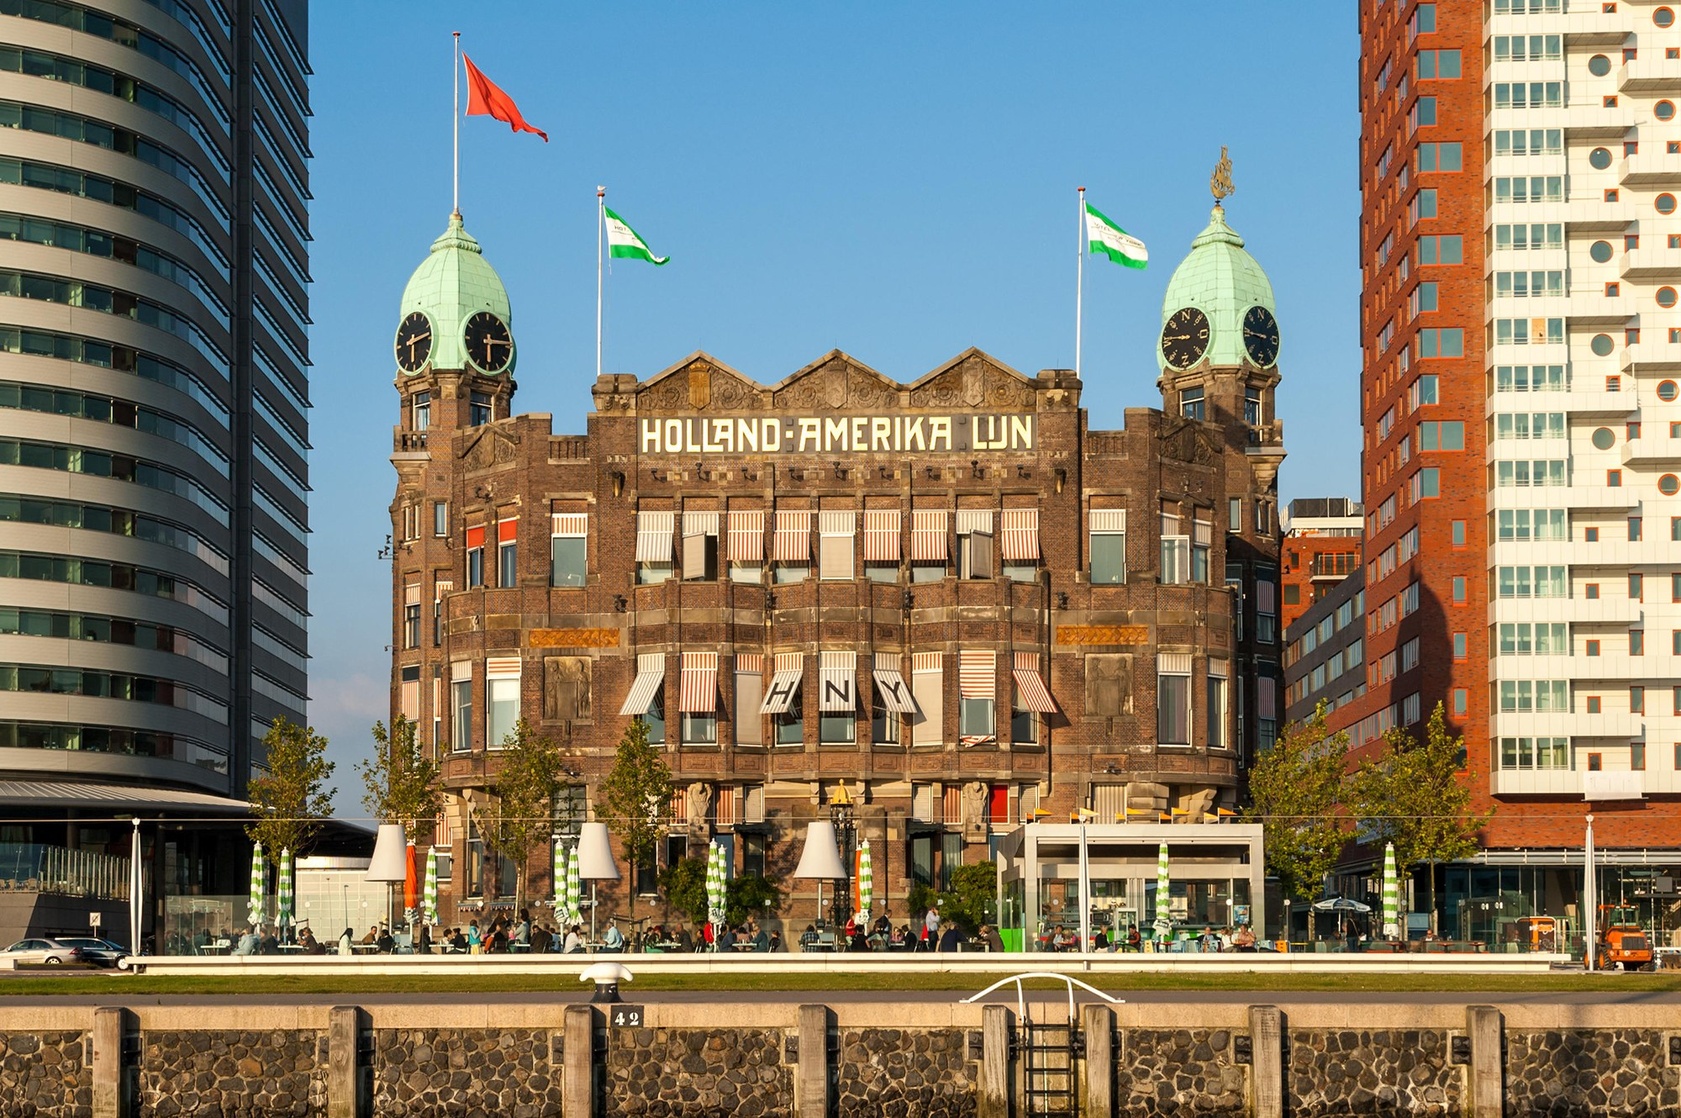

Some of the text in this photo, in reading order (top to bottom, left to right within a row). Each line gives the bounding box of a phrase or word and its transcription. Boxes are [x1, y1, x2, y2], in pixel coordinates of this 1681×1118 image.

[1181, 309, 1191, 321] N
[1257, 308, 1265, 320] N
[614, 1012, 640, 1026] 42
